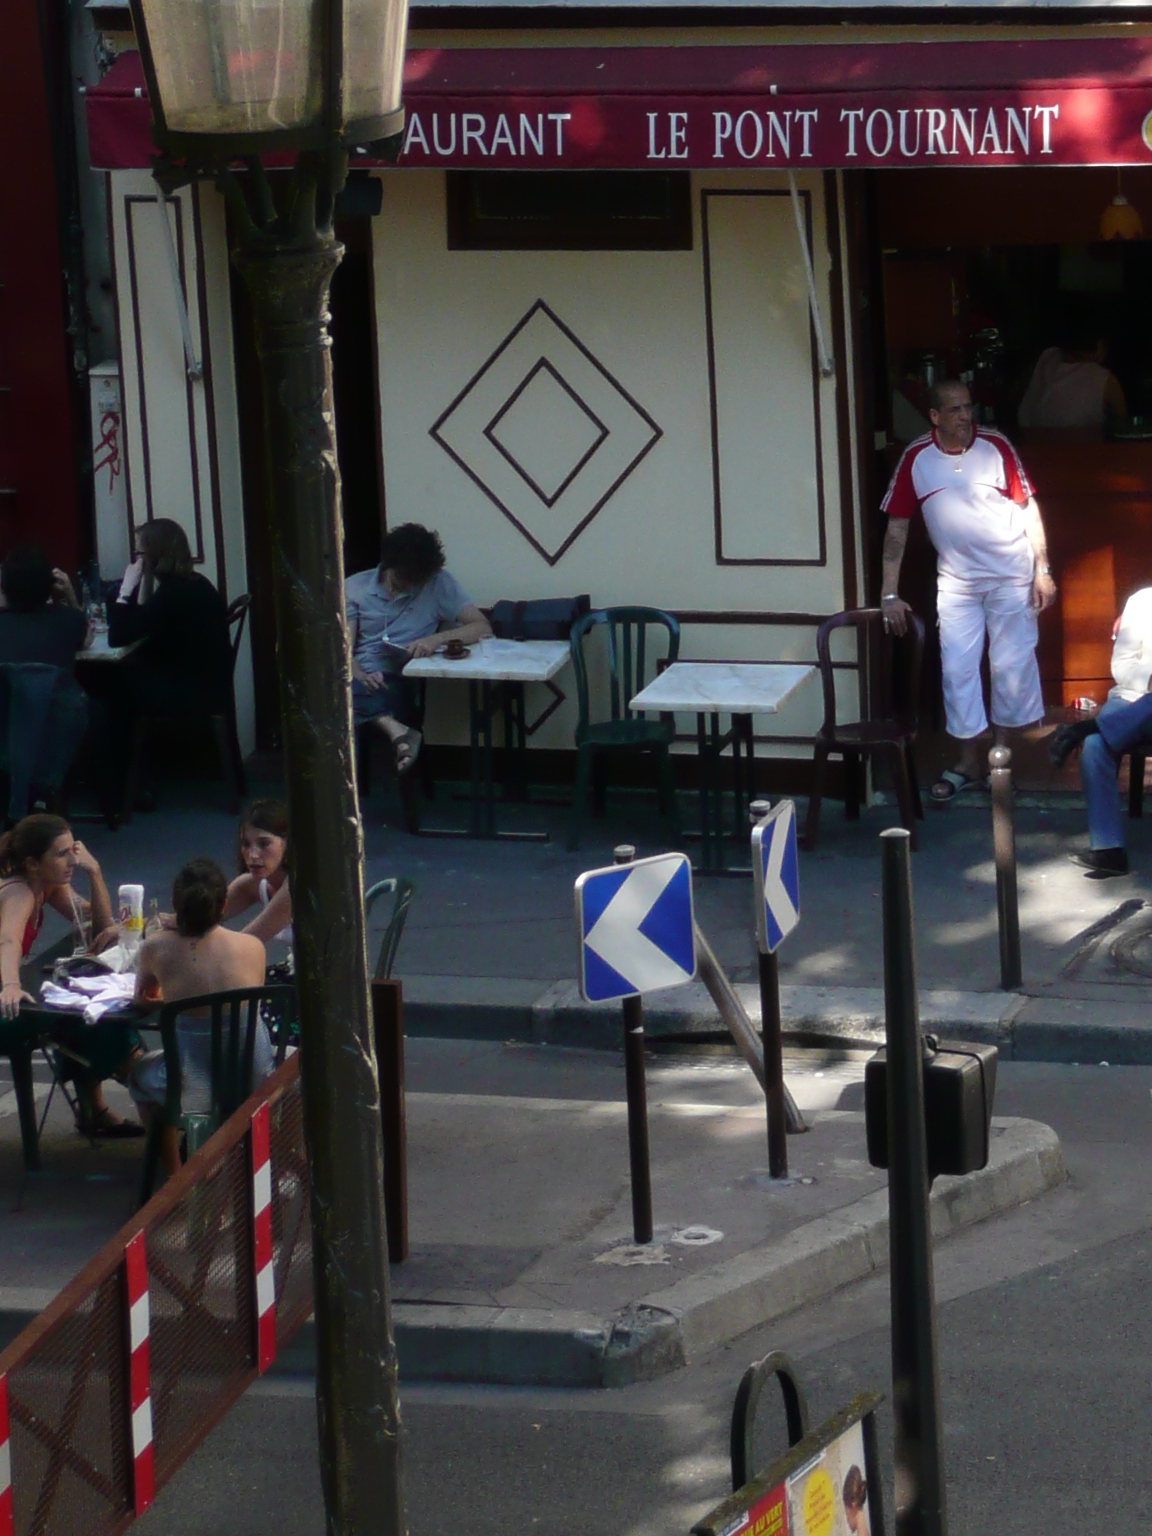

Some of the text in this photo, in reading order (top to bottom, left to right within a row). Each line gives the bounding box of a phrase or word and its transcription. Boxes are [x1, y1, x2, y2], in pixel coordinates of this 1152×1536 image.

[403, 104, 1060, 158] AURANT LE PONT TOURNANT
